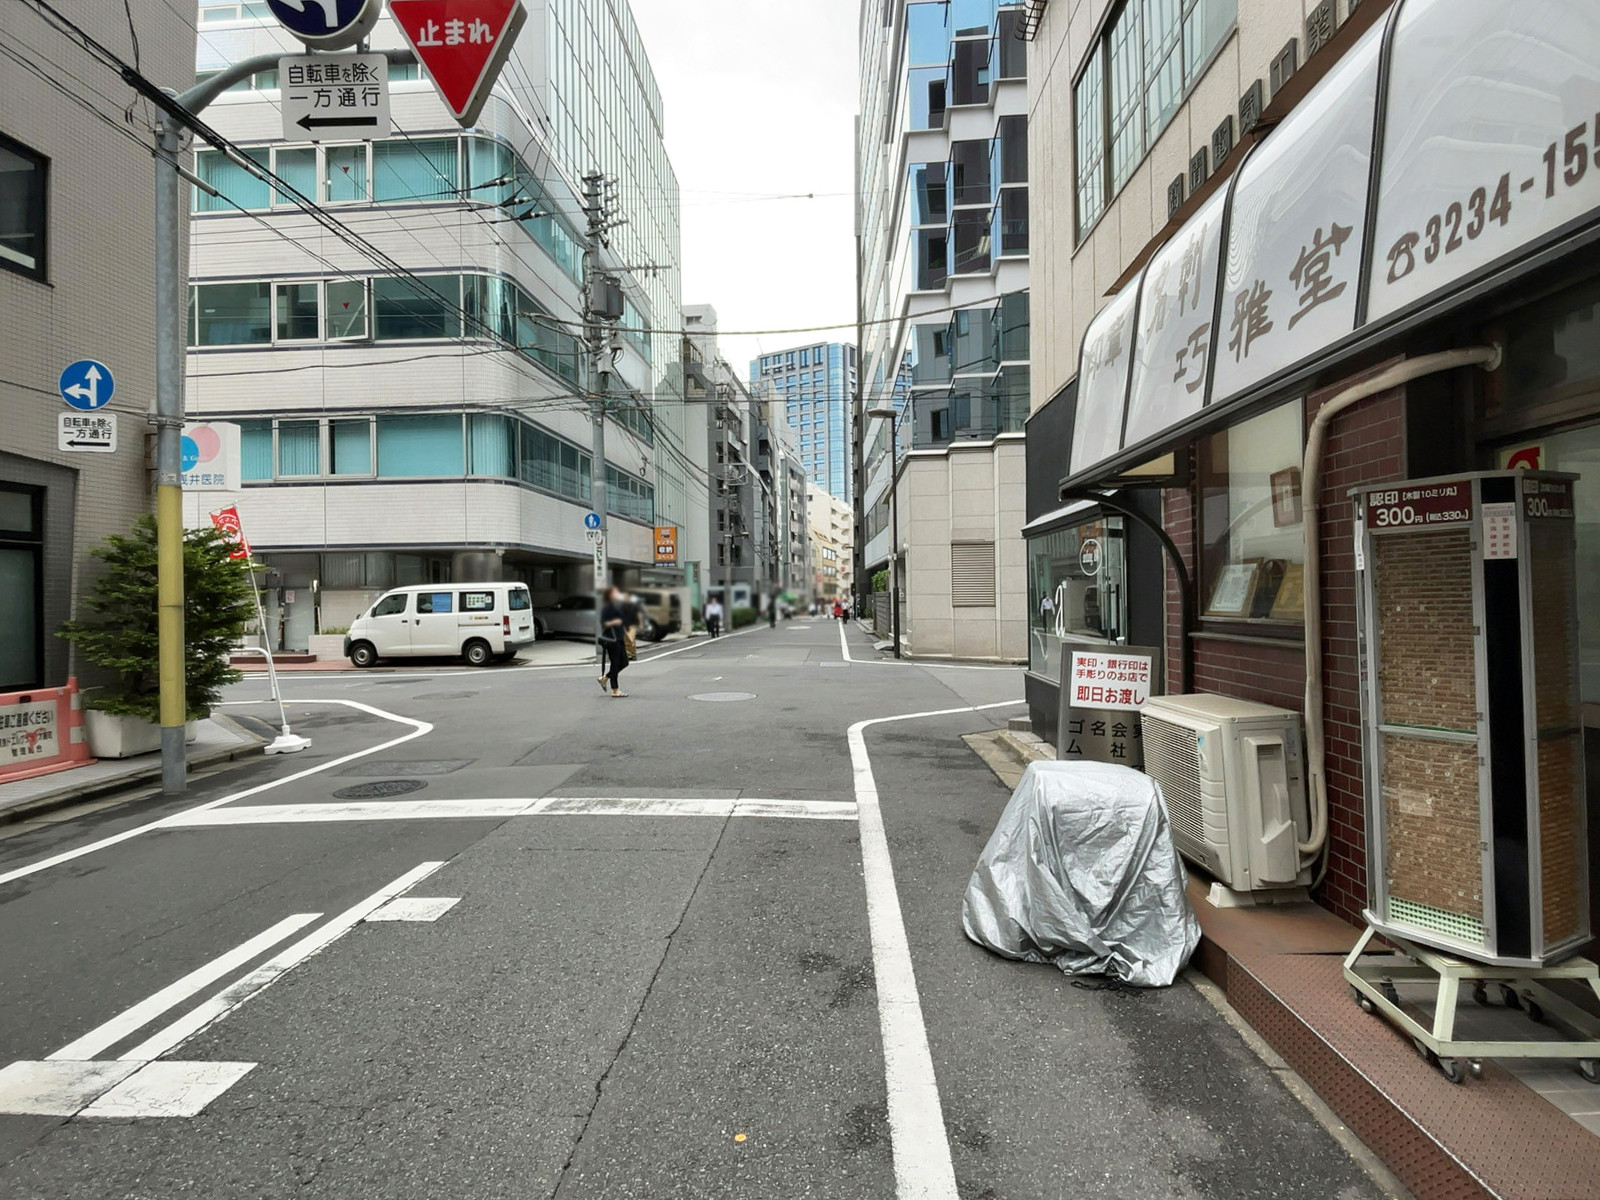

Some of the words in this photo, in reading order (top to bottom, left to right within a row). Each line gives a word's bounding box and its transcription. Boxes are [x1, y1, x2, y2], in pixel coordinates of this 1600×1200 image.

[417, 17, 494, 46] 止まれ
[288, 62, 379, 84] 自転車を除く
[289, 87, 381, 108] 一方通行
[1423, 111, 1600, 264] 3234-15
[1173, 222, 1354, 395] 巧雅堂
[63, 417, 112, 430] 自転車を除く
[63, 429, 112, 440] 一方通行
[1369, 491, 1399, 507] 認印
[1376, 506, 1423, 526] 300円
[1076, 657, 1148, 671] 実印・銀行印は
[1076, 669, 1148, 682] 手彫りのお店で
[1076, 685, 1145, 705] 即日お渡し
